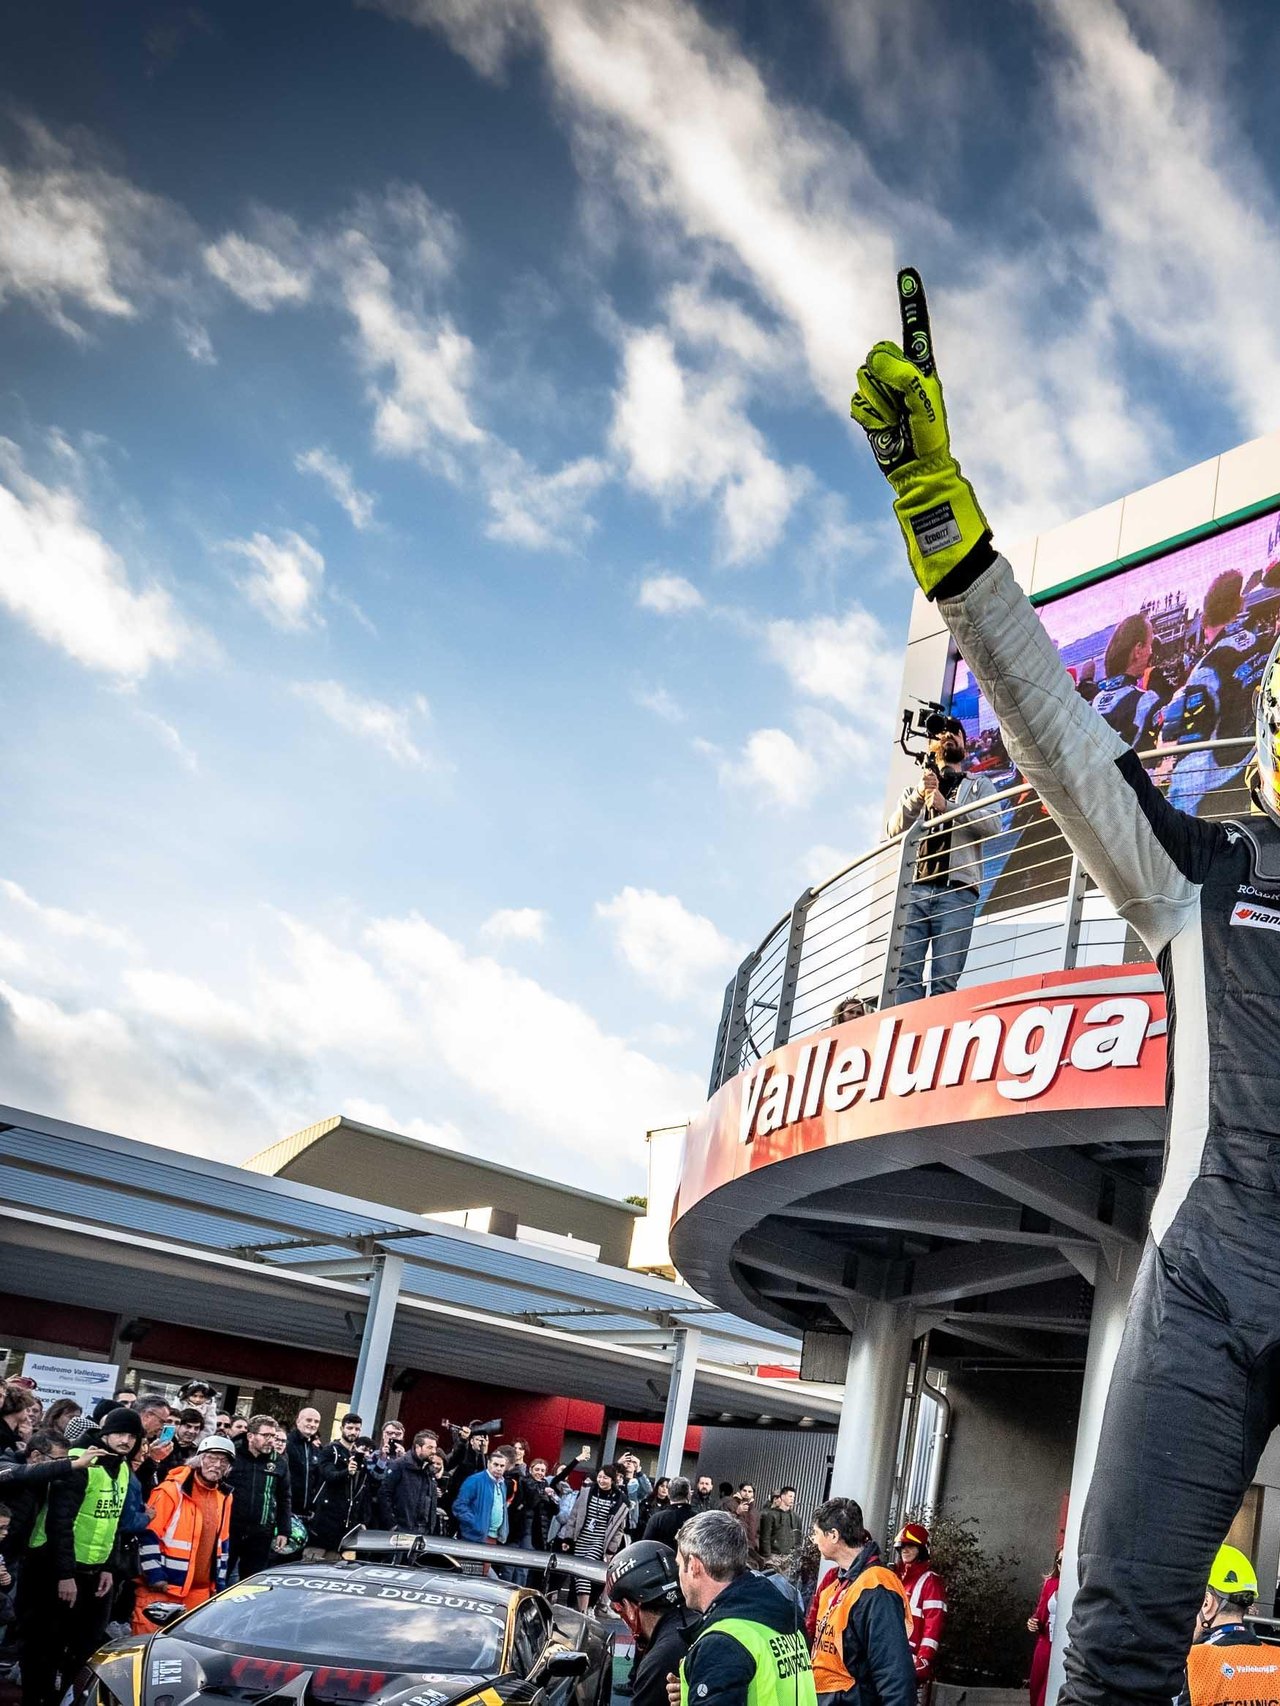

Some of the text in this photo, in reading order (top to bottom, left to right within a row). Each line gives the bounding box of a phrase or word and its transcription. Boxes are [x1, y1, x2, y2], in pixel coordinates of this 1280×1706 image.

[738, 997, 1152, 1144] Vallelunga
[31, 1363, 111, 1379] Autodromo Vallelunga
[258, 1575, 496, 1614] ROGER DUBUIS
